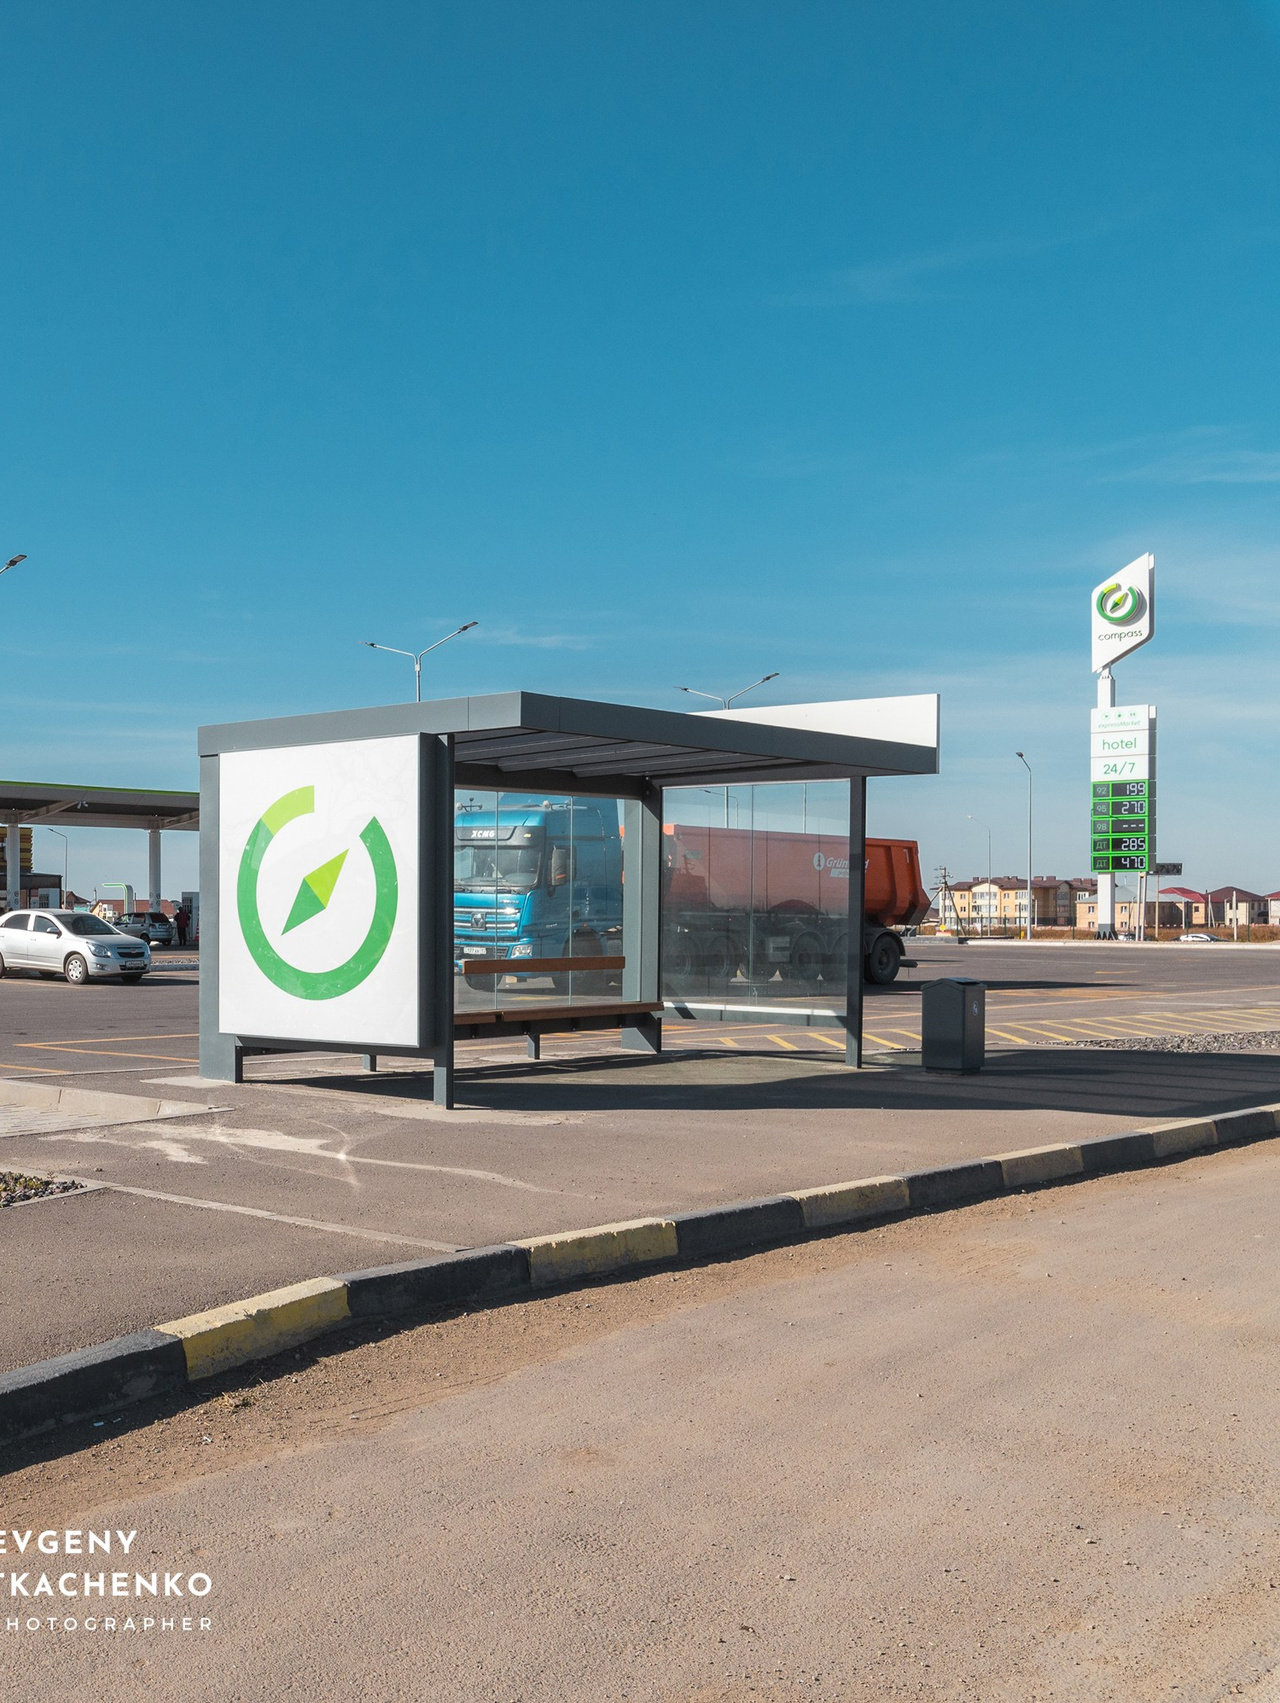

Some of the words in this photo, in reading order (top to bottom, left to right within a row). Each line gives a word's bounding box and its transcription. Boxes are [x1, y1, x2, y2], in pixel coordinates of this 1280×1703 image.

[1098, 630, 1142, 641] compass
[1102, 738, 1137, 751] hotel
[1103, 762, 1135, 775] 24/7
[1096, 787, 1107, 795] 92
[1126, 782, 1146, 796] 199
[1096, 805, 1107, 813] 95
[1121, 801, 1146, 814] 270
[1096, 823, 1107, 831] 98
[471, 830, 495, 838] XCMG
[1121, 838, 1146, 851] 285
[1121, 856, 1146, 869] 470
